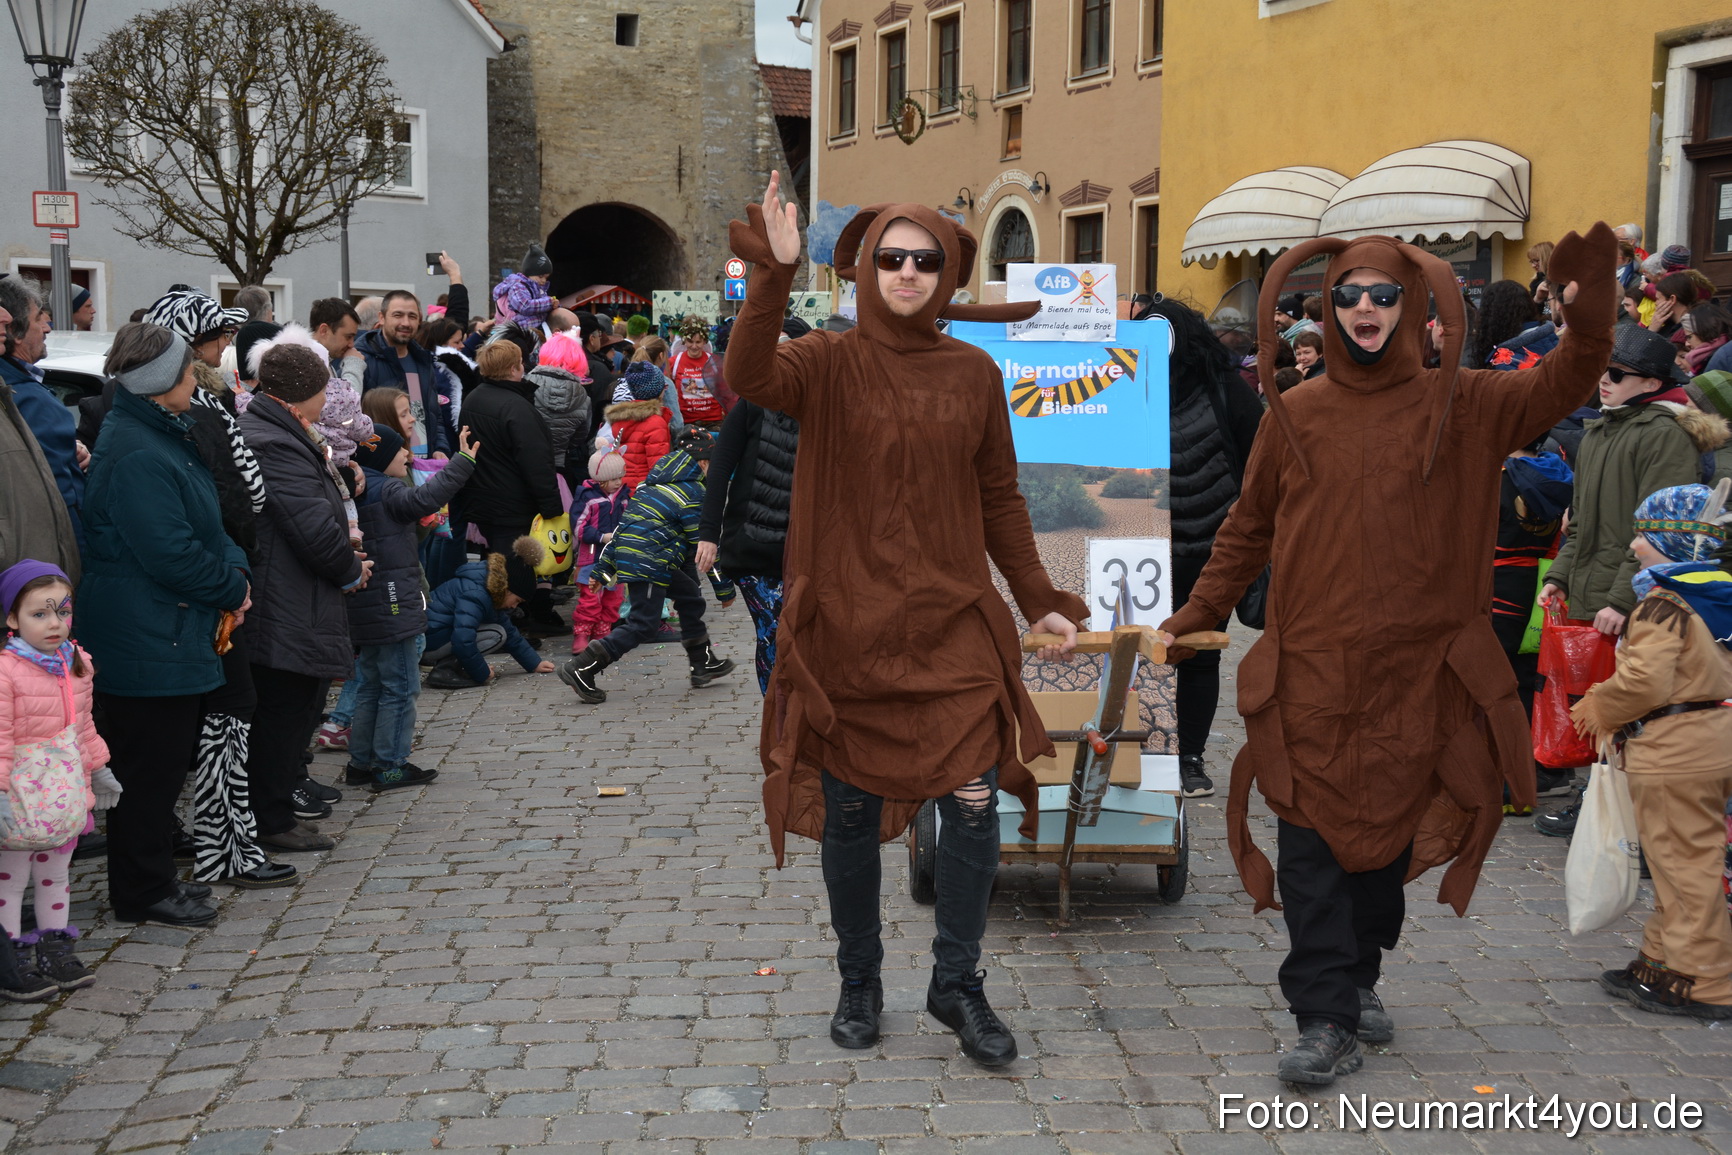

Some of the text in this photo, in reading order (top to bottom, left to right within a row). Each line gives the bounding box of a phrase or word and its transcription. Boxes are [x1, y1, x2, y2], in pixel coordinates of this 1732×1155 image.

[1042, 275, 1071, 289] AfB
[791, 306, 832, 320] Staufers
[1095, 306, 1111, 315] tot,
[1026, 321, 1069, 330] Marmelade
[1073, 322, 1090, 331] aufs
[1094, 322, 1112, 331] Brot
[1041, 388, 1056, 398] für
[1041, 400, 1108, 415] Bienen
[1098, 557, 1162, 611] 33
